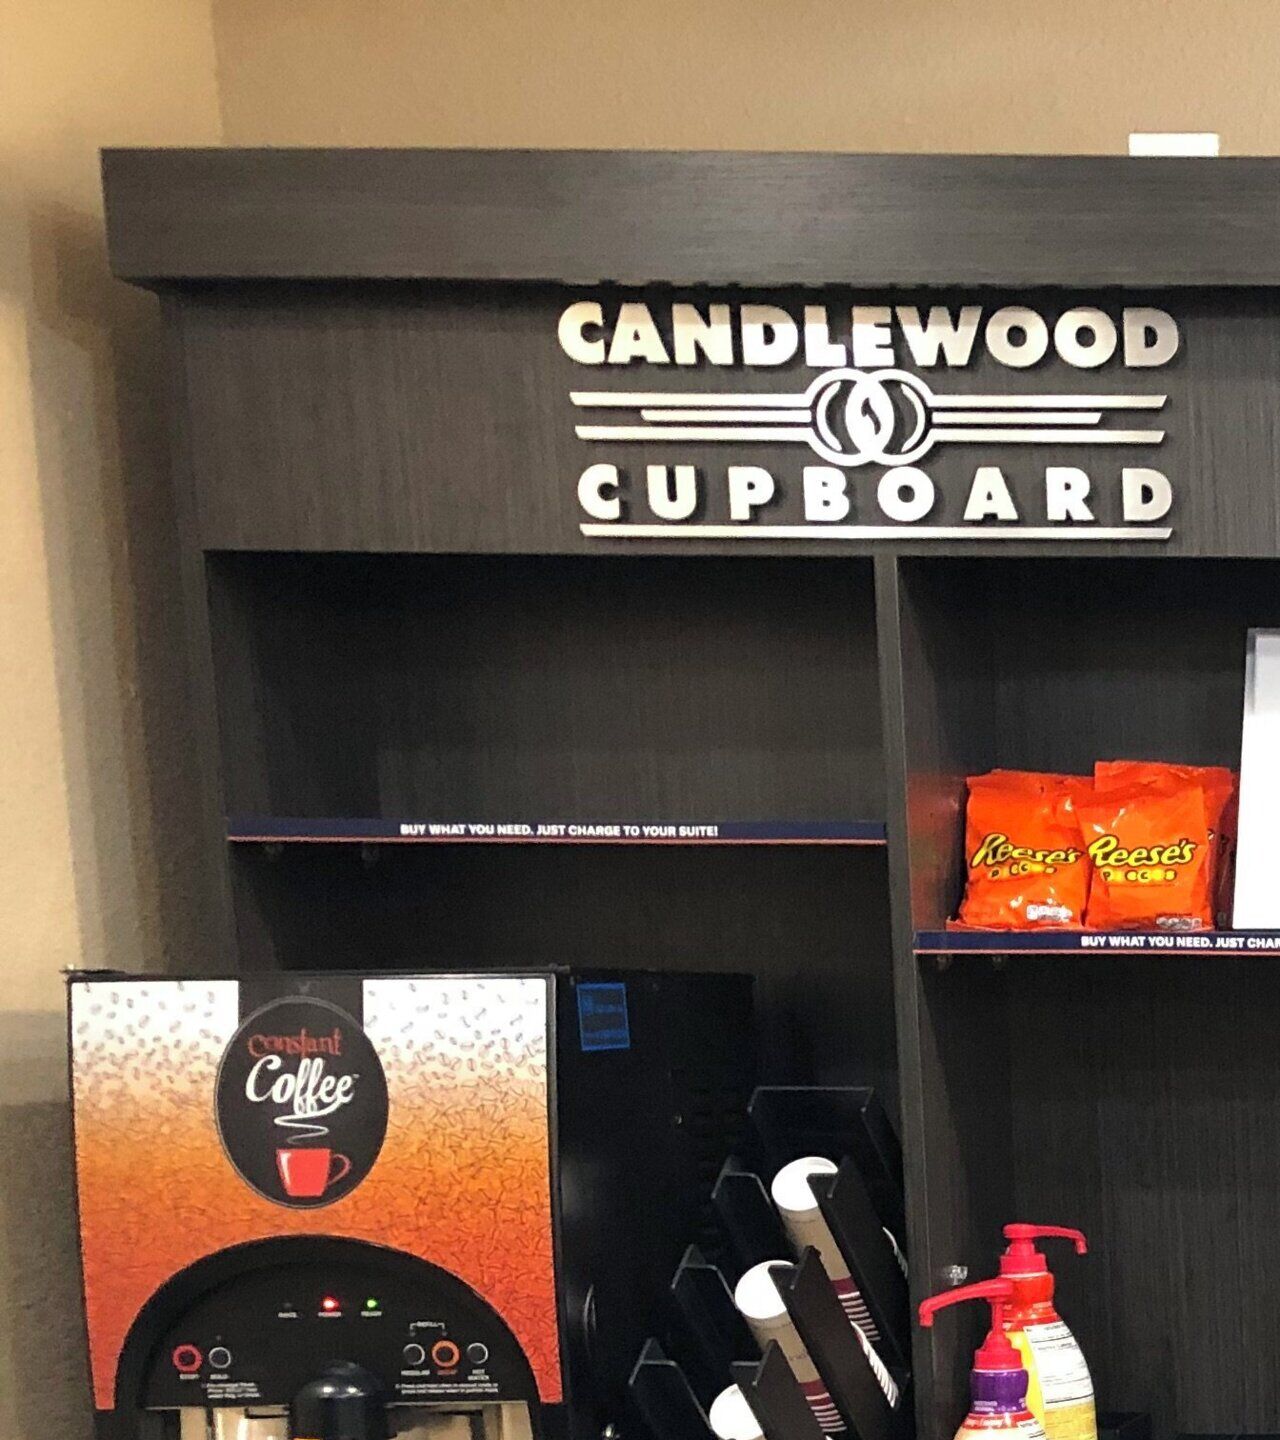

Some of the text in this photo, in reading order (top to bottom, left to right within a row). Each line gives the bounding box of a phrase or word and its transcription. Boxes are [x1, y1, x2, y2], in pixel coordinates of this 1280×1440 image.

[558, 302, 1179, 368] CANDLEWOOD
[577, 464, 1173, 522] CUPBOARD
[400, 823, 718, 837] BUY WHAT YOU NEED. JUST CHARGE TO YOUR SUITE!
[971, 833, 1081, 869] Reese's
[1088, 835, 1198, 868] Reese's
[1081, 936, 1106, 947] BUY
[1109, 936, 1146, 947] WHAT
[1148, 936, 1174, 947] YOU
[1176, 937, 1213, 948] NEED.
[1215, 937, 1245, 948] JUST
[246, 1055, 355, 1116] Coffee
